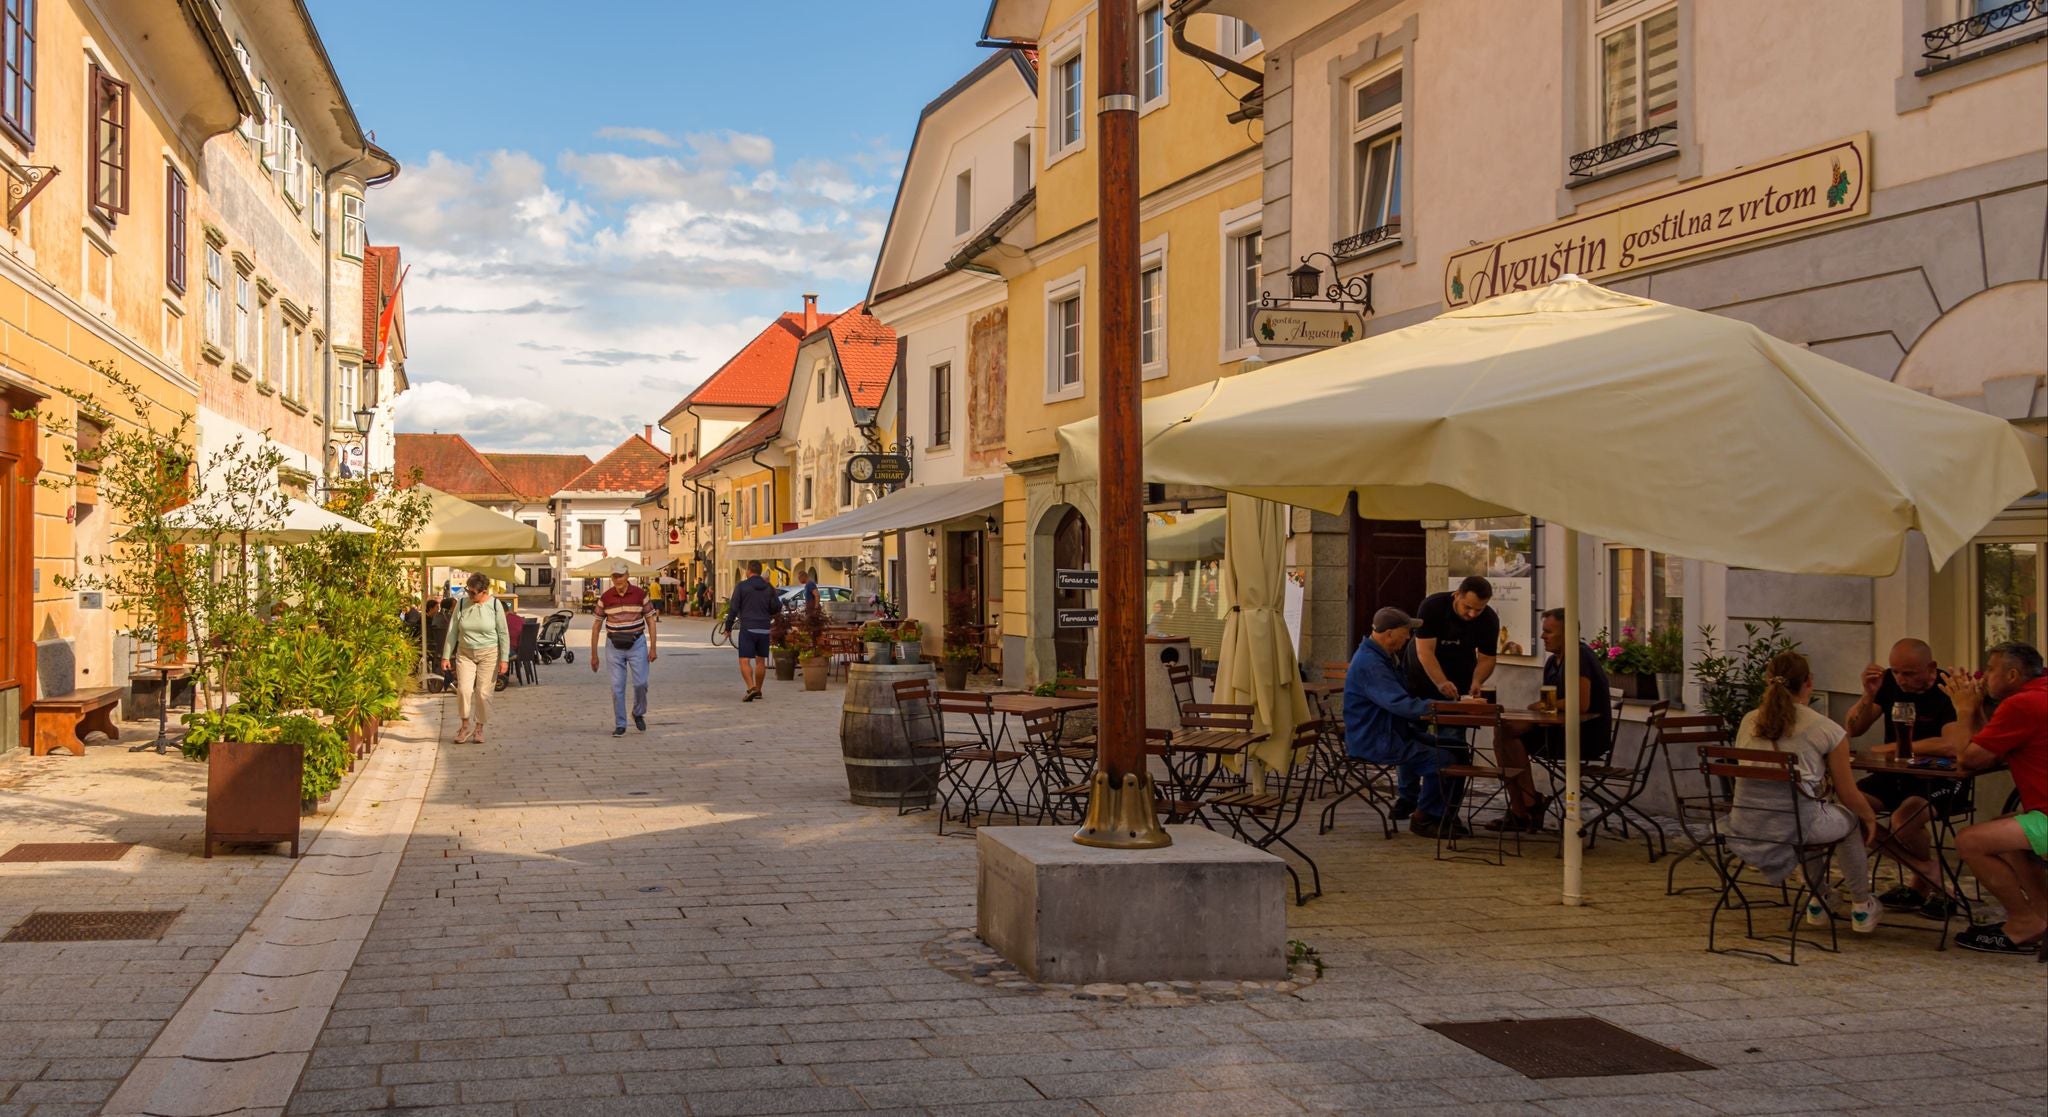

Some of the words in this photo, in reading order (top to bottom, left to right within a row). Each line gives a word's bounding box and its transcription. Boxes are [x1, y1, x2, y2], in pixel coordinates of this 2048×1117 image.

[1469, 235, 1606, 305] Avguštin
[1619, 209, 1711, 268] gostilna
[1718, 206, 1734, 229] z
[1739, 184, 1816, 223] vrtom
